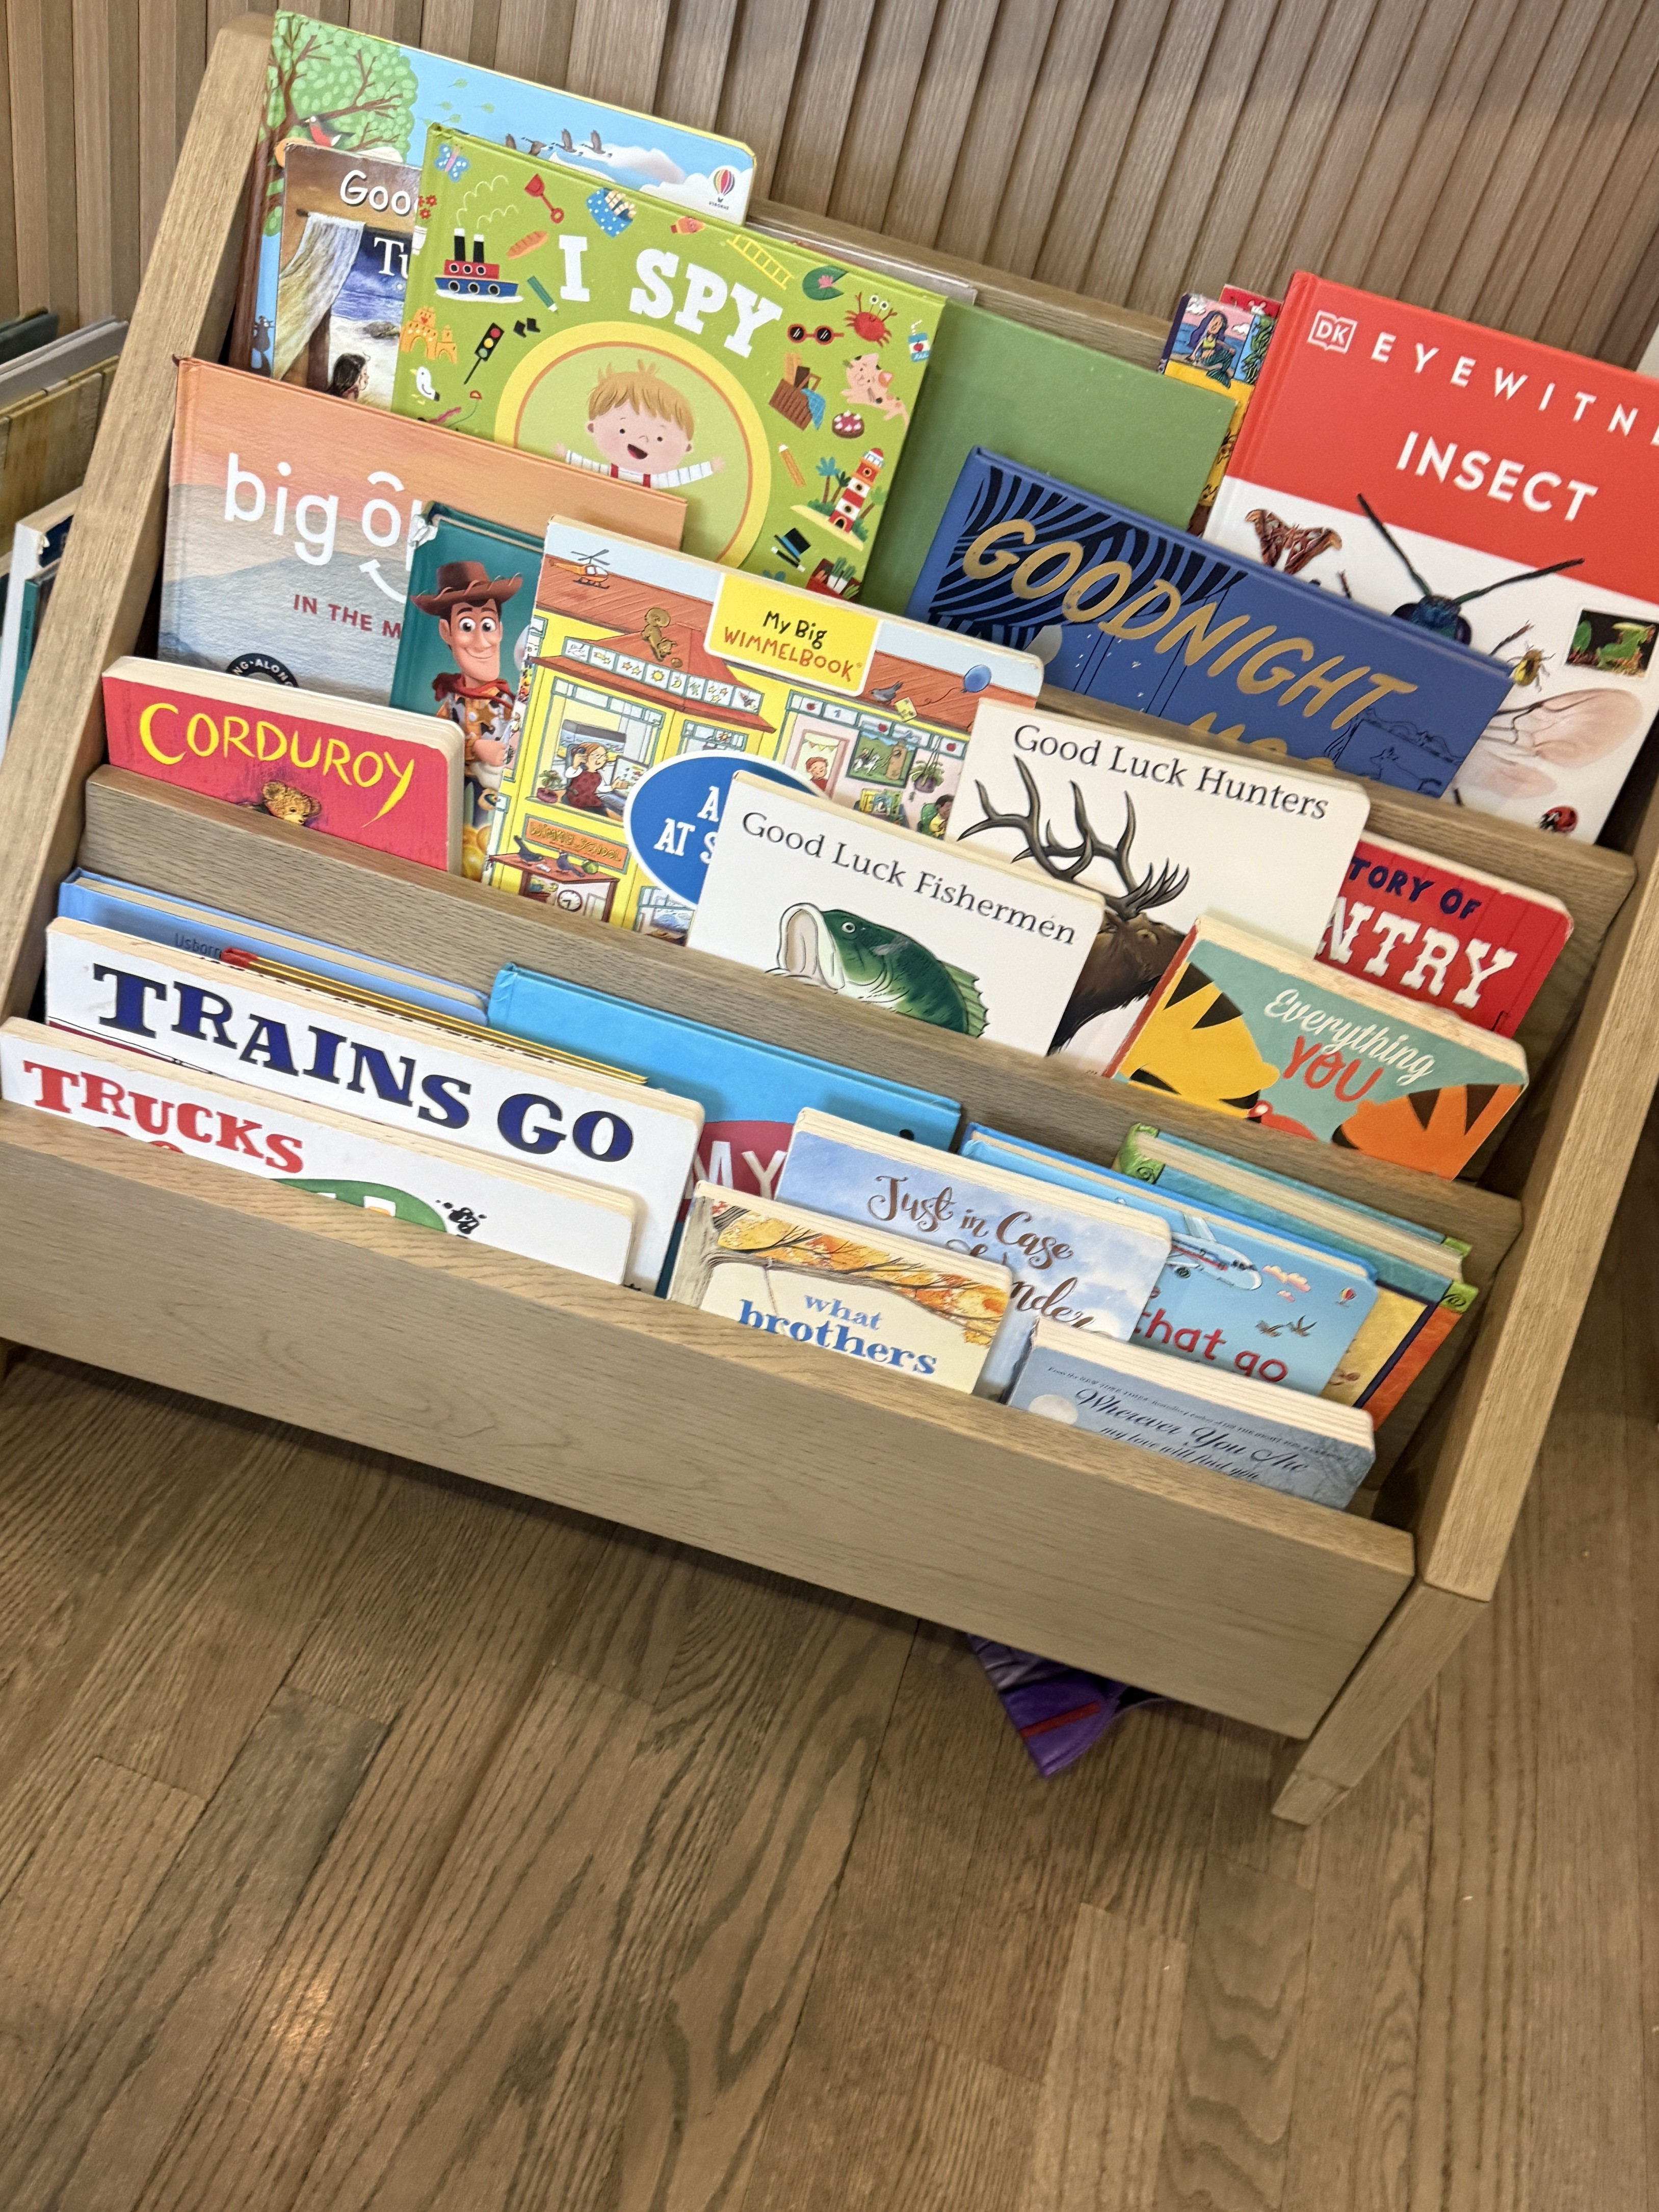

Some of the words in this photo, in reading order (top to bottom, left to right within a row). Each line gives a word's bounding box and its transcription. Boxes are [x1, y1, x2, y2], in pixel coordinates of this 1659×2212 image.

[340, 170, 418, 215] Goo
[559, 234, 590, 302] I
[629, 249, 783, 357] SPY
[224, 453, 339, 565] big
[1396, 431, 1599, 521] INSECT
[294, 594, 318, 614] IN
[328, 604, 372, 631] THE
[762, 611, 792, 635] My
[795, 619, 828, 650] Big
[963, 519, 1418, 730] GOODNIGHT
[140, 703, 414, 828] CORDUROY
[697, 785, 719, 822] A
[1014, 724, 1101, 767] Good
[1108, 746, 1188, 787] Luck
[1194, 766, 1329, 820] Hunters
[653, 818, 696, 855] AT
[742, 812, 826, 858] Good
[832, 841, 908, 887] Luck
[913, 871, 1076, 945] Fishermen
[1439, 887, 1482, 920] OF
[175, 933, 222, 958] Usborn
[93, 963, 472, 1130] TRAINS
[497, 1093, 634, 1162] GO
[1263, 988, 1436, 1086] Everything
[1282, 1035, 1385, 1102] YOU
[23, 1060, 304, 1174] TRUCKS
[867, 1175, 957, 1232] Just
[959, 1208, 989, 1237] in
[996, 1211, 1074, 1270] Case
[738, 1299, 938, 1375] brothers
[804, 1295, 883, 1330] what
[1011, 1277, 1095, 1328] nder
[1075, 1388, 1182, 1435] Wherever
[1190, 1427, 1247, 1455] You
[1250, 1449, 1308, 1472] Are
[1099, 1428, 1127, 1440] my
